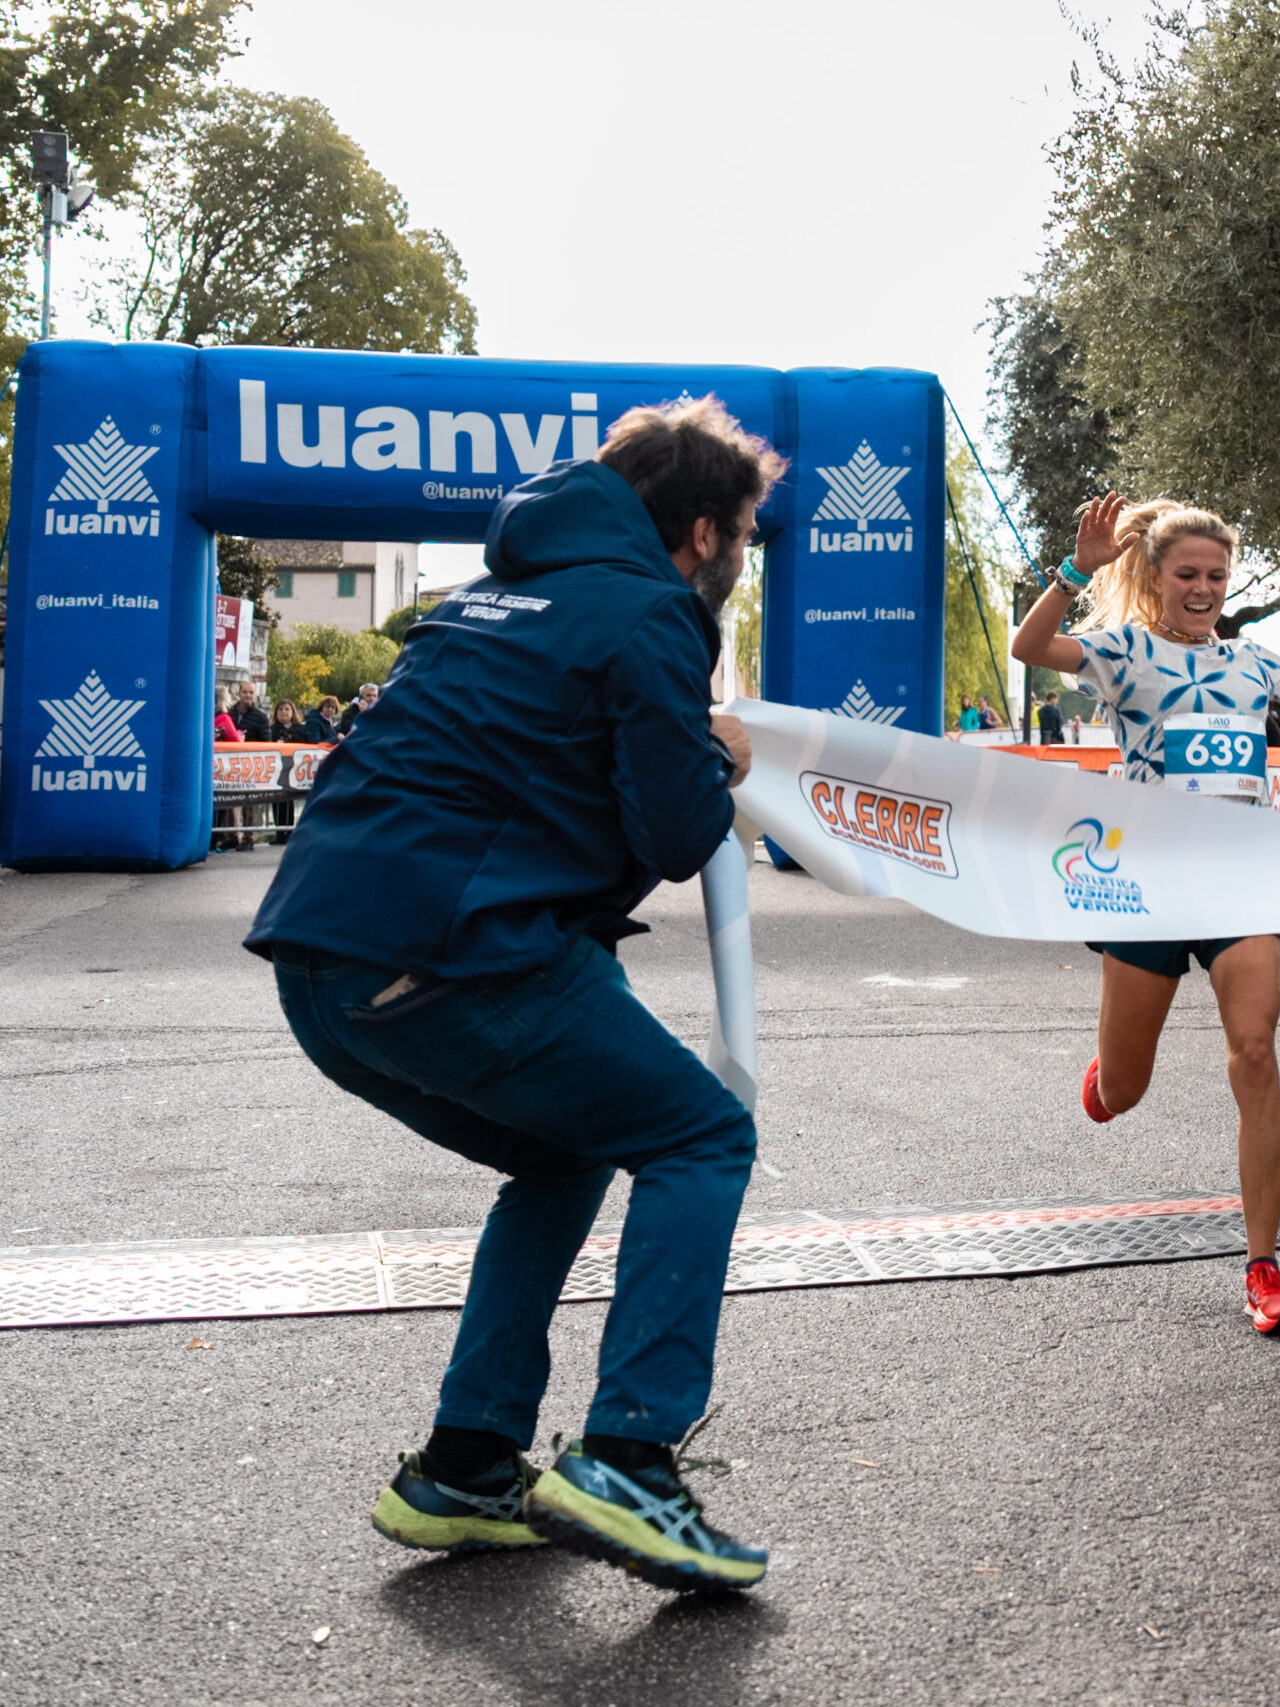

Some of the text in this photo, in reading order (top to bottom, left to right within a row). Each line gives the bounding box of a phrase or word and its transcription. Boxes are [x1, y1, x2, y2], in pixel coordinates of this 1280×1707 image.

[239, 379, 598, 474] luanvi
[45, 508, 160, 537] luanvi
[810, 527, 913, 553] luanvi
[36, 593, 159, 610] @luanvi_italia
[804, 607, 916, 624] @luanvi_italia
[1185, 733, 1254, 767] 639
[32, 764, 146, 792] luanvi
[811, 781, 944, 858] CI.ERRE
